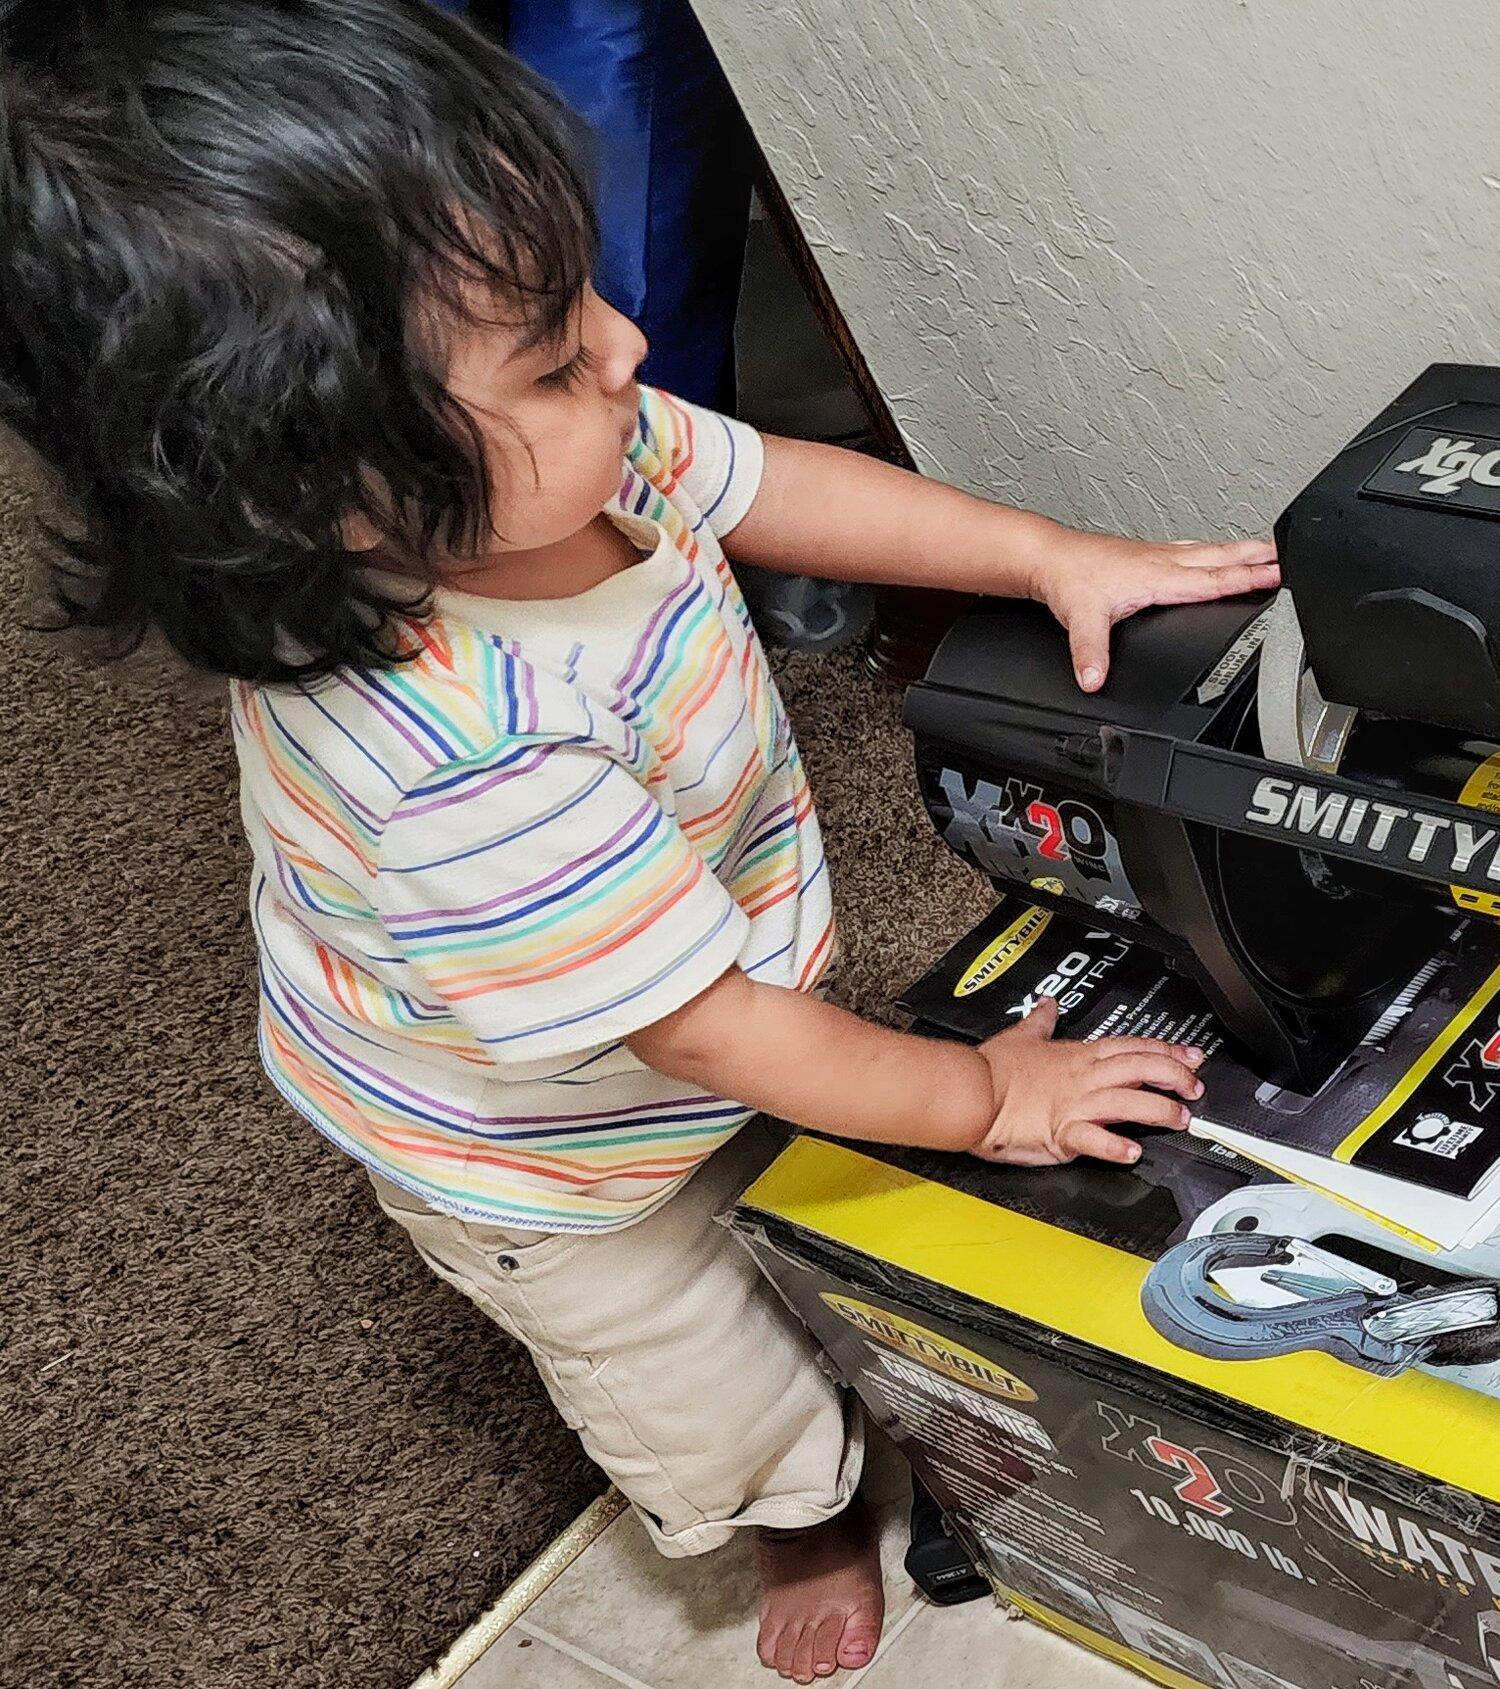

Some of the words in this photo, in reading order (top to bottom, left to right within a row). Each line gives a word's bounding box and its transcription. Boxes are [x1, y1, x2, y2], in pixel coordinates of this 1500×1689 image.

[1208, 649, 1241, 684] SPOOL
[1241, 618, 1268, 642] WIRE
[1218, 654, 1248, 685] DRUM
[1246, 637, 1260, 649] IN
[1000, 777, 1108, 862] X20
[1005, 951, 1090, 1019] X20
[1125, 976, 1170, 1020] Precautions
[836, 1301, 1019, 1396] SMITTYBILT
[877, 1353, 956, 1405] COMP
[954, 1391, 1052, 1452] SERIES
[1096, 1400, 1299, 1528] X20
[1131, 1487, 1258, 1562] 10,000
[1259, 1540, 1319, 1588] lb.
[1360, 1542, 1471, 1597] SERIES
